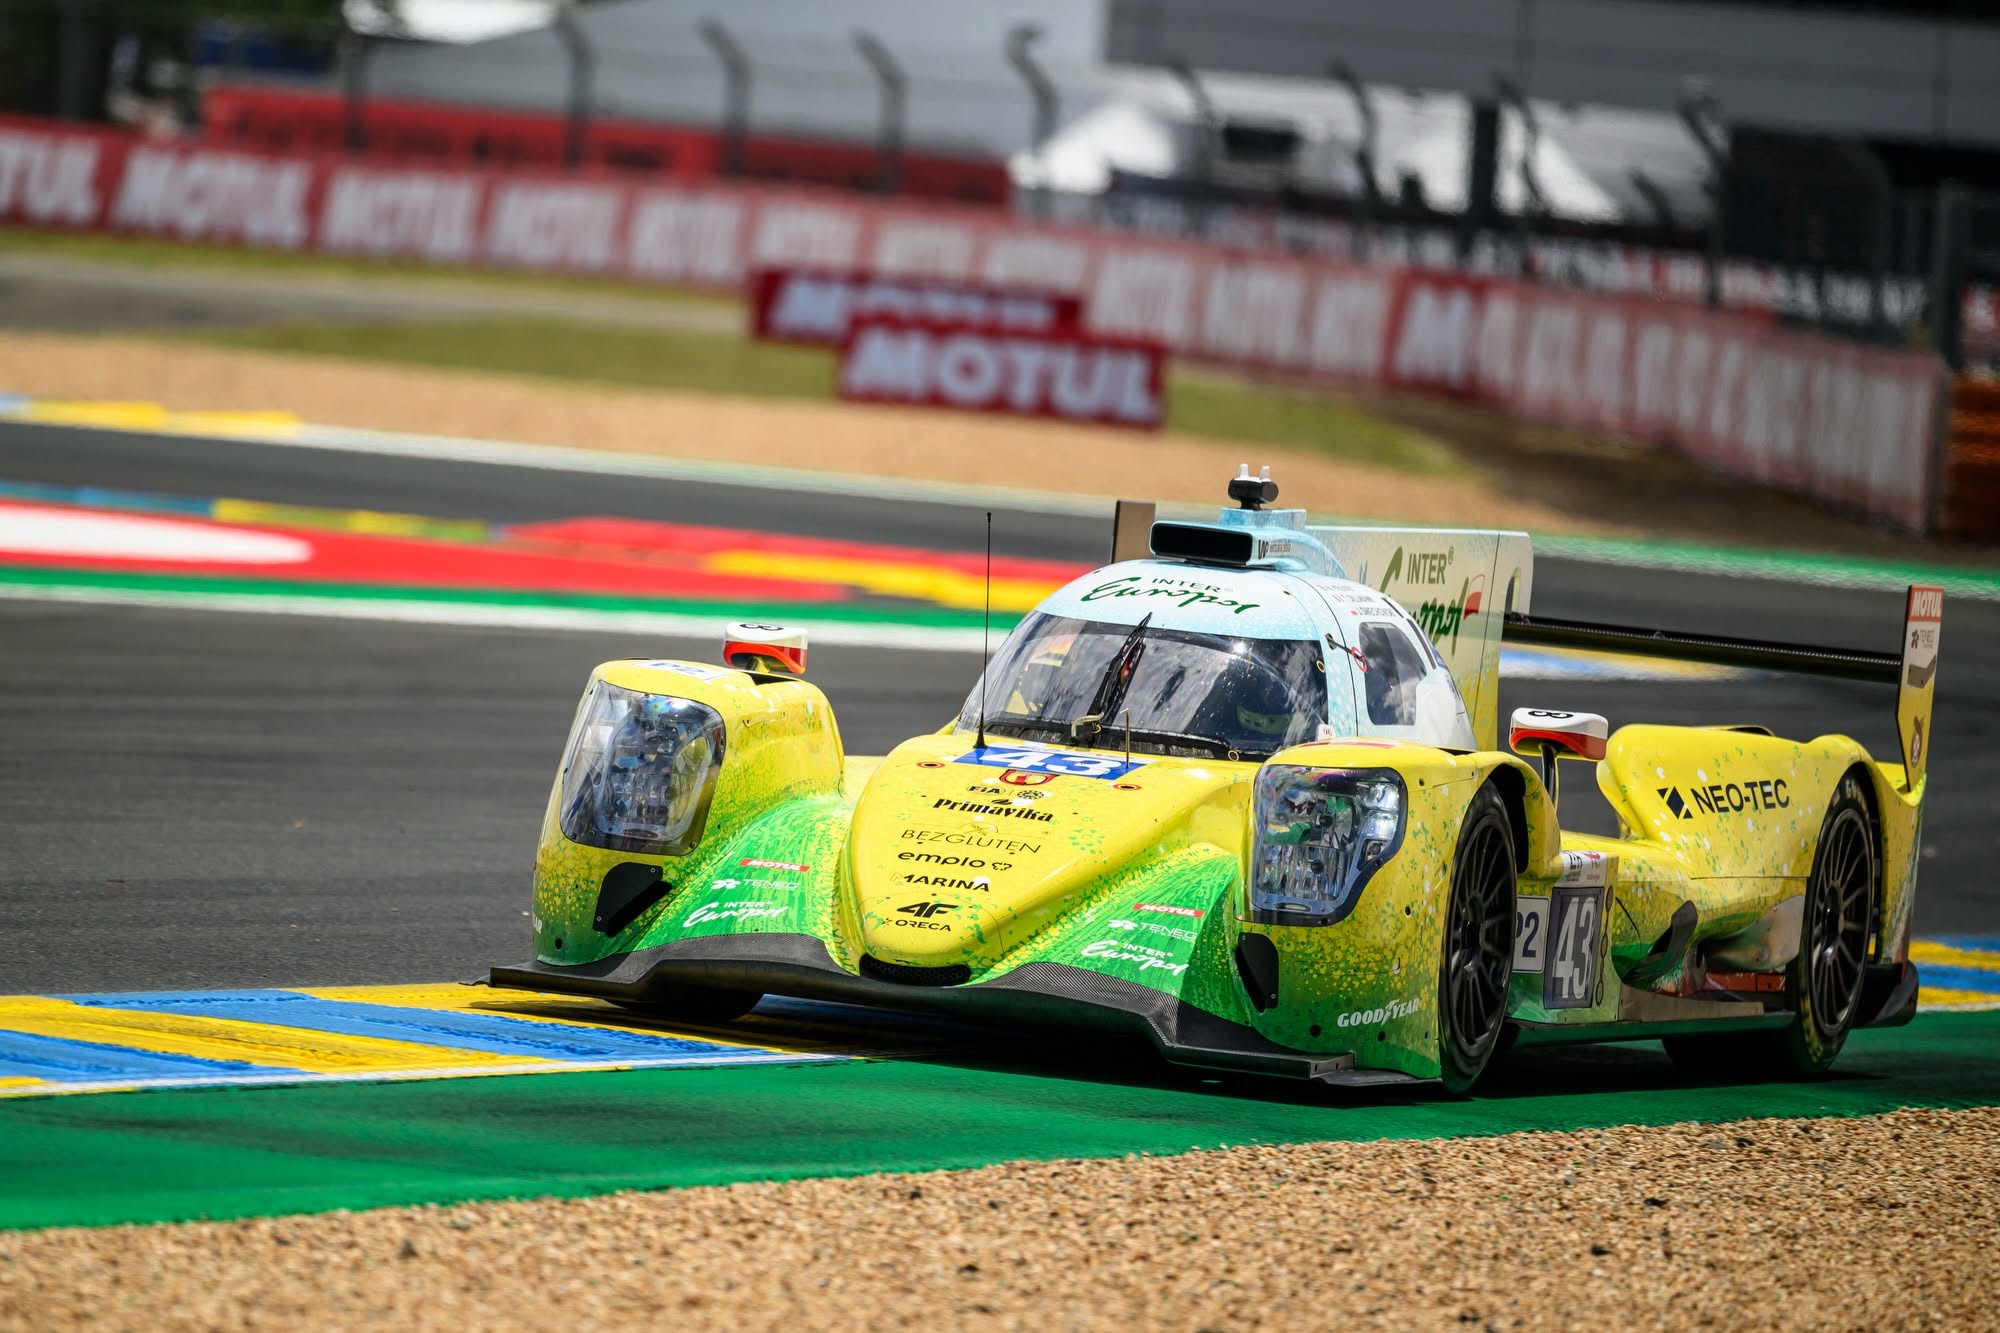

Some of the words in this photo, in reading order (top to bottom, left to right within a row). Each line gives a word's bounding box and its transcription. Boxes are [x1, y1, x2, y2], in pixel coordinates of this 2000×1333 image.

[843, 325, 1158, 422] MOTUL
[1911, 590, 1942, 618] MOTUL
[979, 751, 1122, 776] 43
[1690, 779, 1790, 815] NEO-TEC
[933, 798, 1054, 822] Primavika
[901, 829, 1041, 854] BEZGLUTEN
[747, 859, 801, 871] MOTUL
[898, 852, 986, 868] emplo
[1140, 904, 1196, 916] MOTUL
[895, 919, 951, 932] ORECA
[1552, 897, 1598, 999] 43
[1337, 998, 1420, 1028] GOODYEAR
